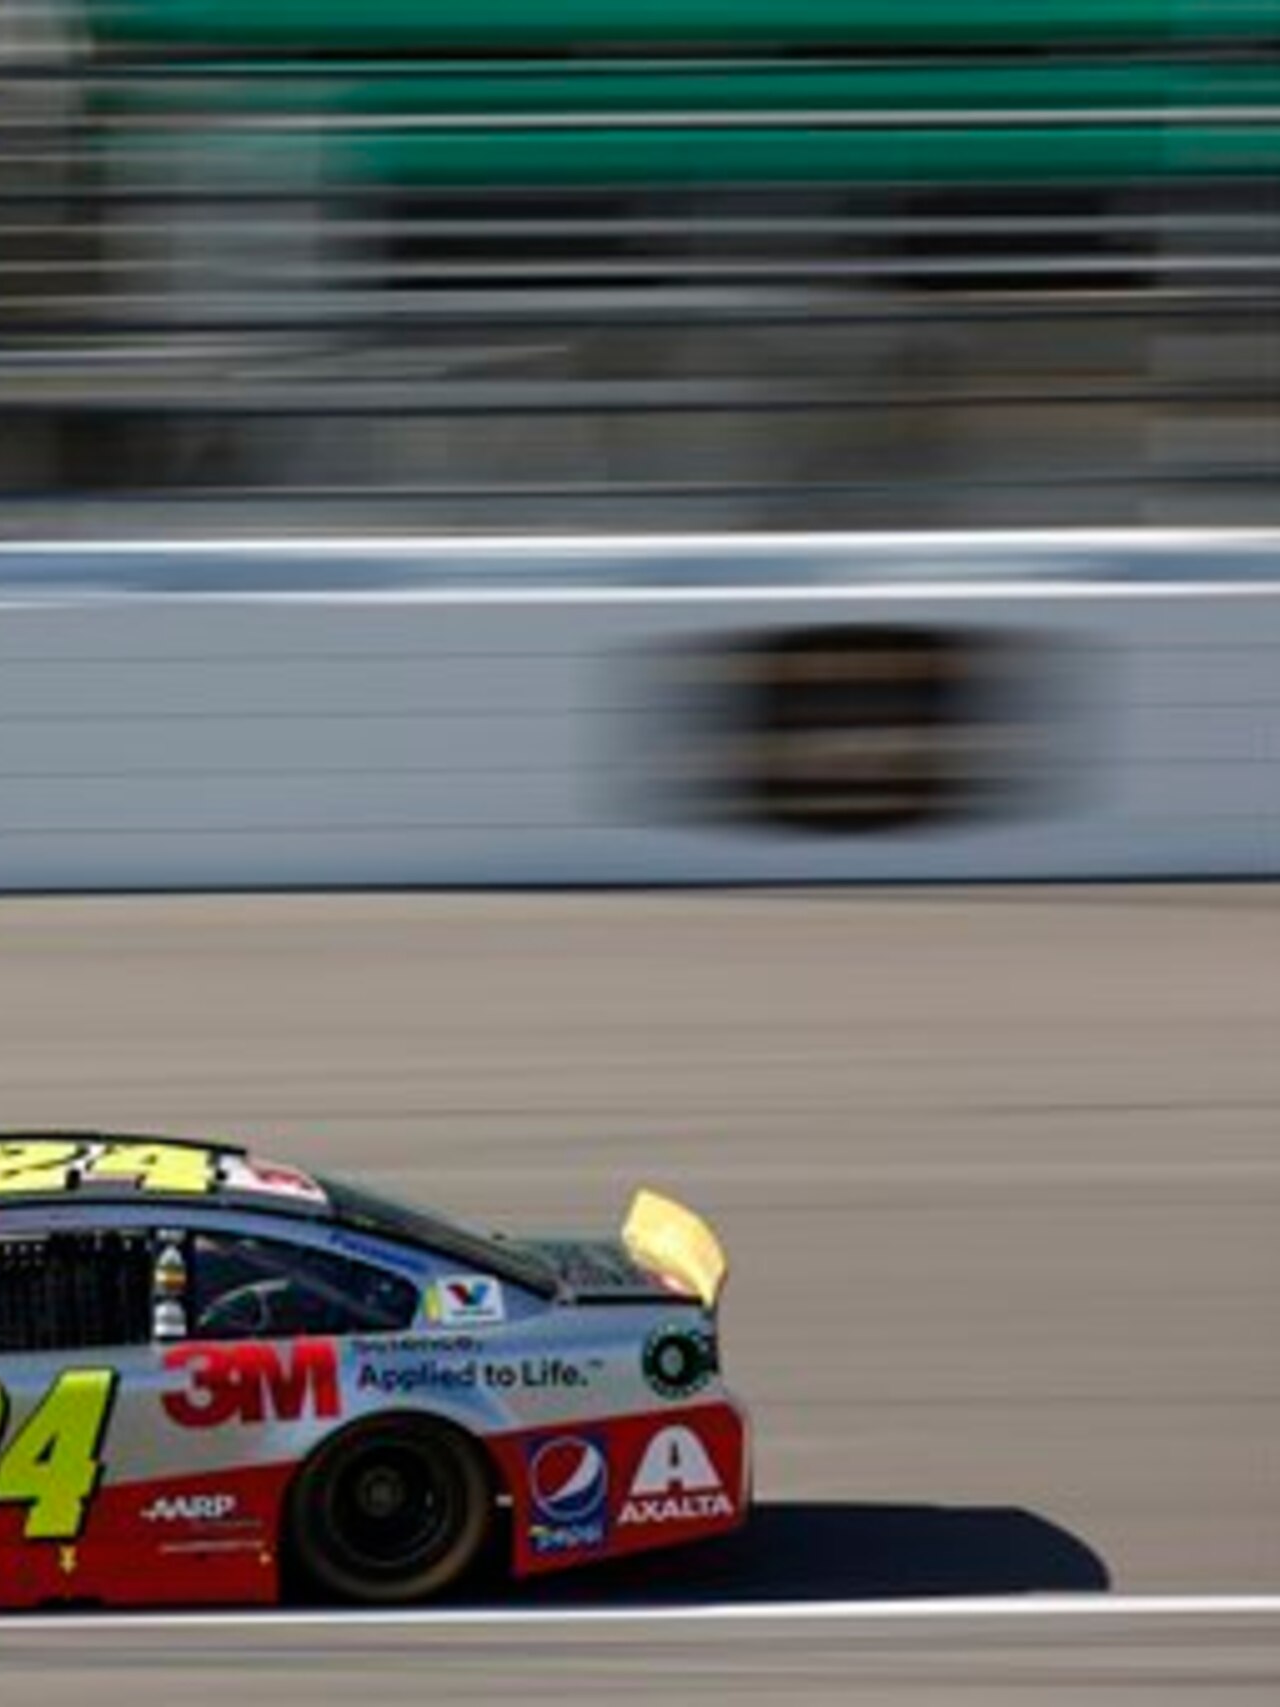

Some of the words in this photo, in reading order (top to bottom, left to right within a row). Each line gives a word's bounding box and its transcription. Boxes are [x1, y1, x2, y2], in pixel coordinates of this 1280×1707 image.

[161, 1338, 341, 1428] 3M
[359, 1361, 477, 1391] Applied
[485, 1361, 518, 1386] to
[617, 1494, 734, 1524] AXALTA
